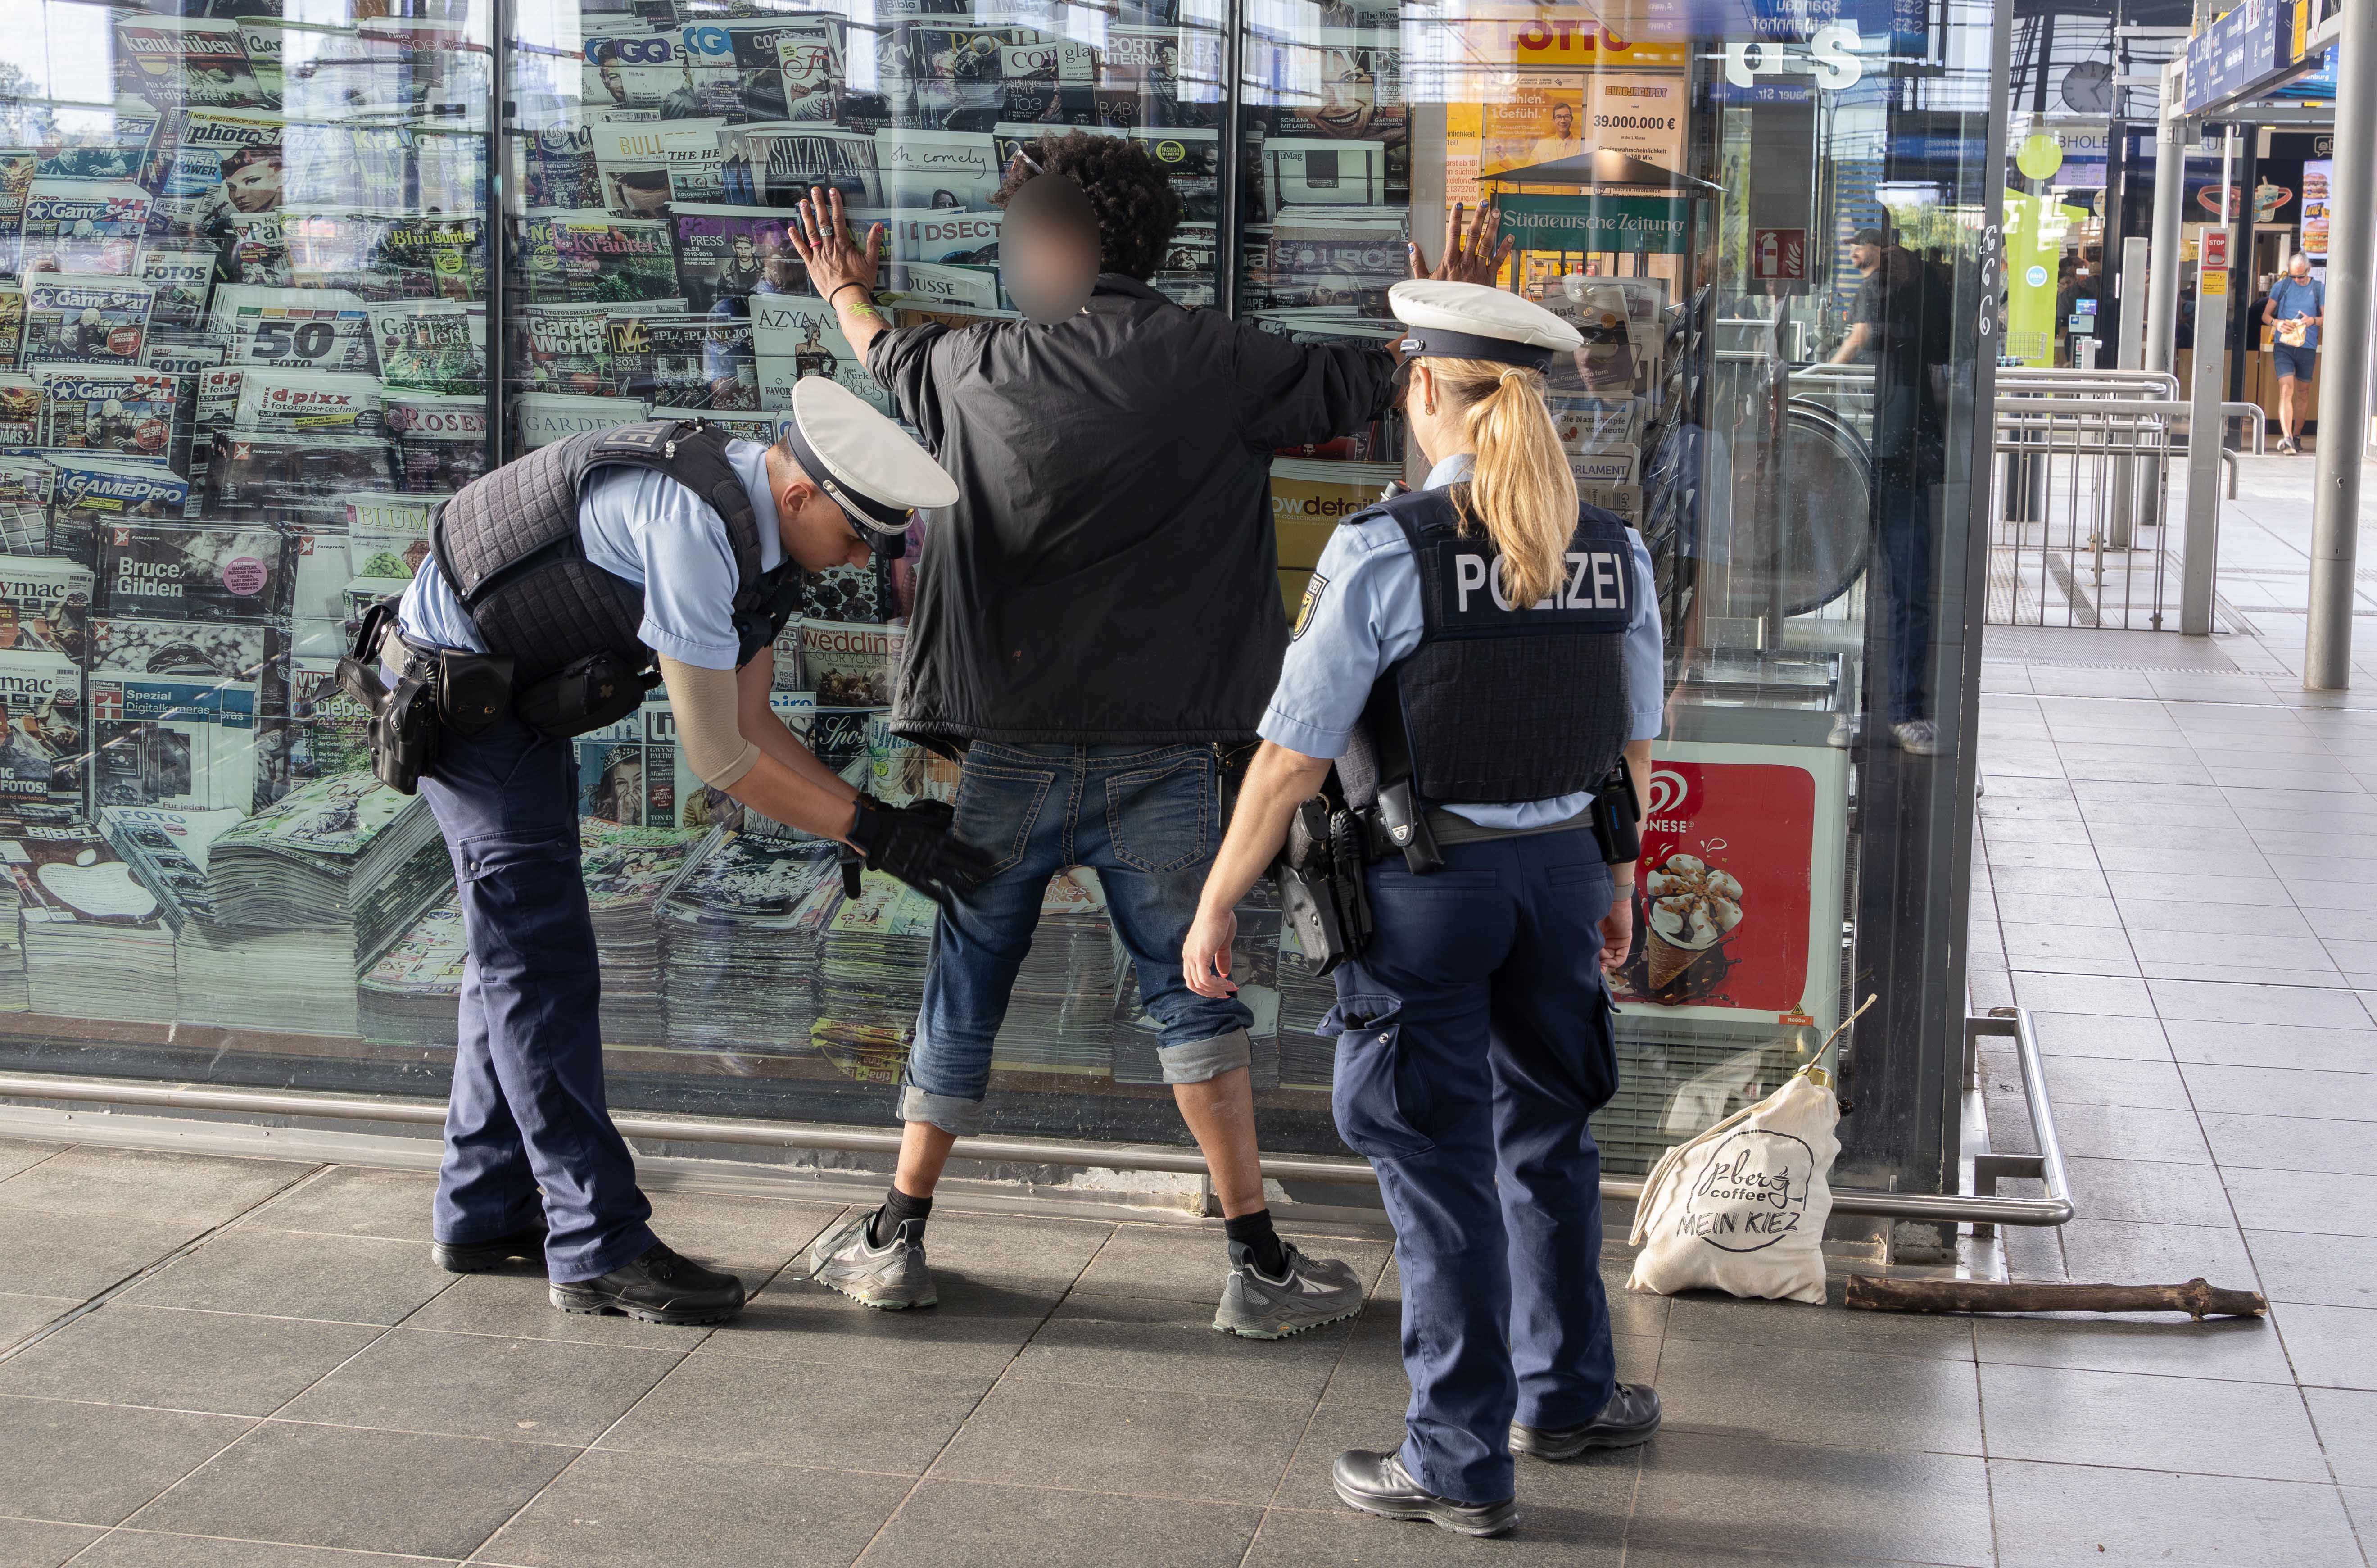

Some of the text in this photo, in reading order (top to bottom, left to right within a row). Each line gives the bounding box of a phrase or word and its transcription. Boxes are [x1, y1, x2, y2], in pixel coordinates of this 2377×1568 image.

[1359, 11, 1399, 19] The Row
[399, 38, 468, 53] special
[614, 38, 673, 63] GQ
[1605, 86, 1667, 98] EUROJACKPOT
[1012, 98, 1042, 111] 103
[1099, 101, 1142, 115] BABY
[209, 115, 248, 124] PHOTOSHOP
[1594, 115, 1675, 130] 39.000.000 €
[668, 151, 697, 160] THE
[1279, 150, 1303, 163] uMag
[923, 148, 986, 179] comely
[1455, 168, 1477, 177] süchtig
[1503, 210, 1684, 237] Süddeutsche Zeitung
[570, 234, 659, 253] Kräuter
[690, 235, 724, 247] PRESS
[1290, 242, 1313, 251] style
[142, 266, 207, 280] FOTOS
[252, 322, 335, 359] 50
[688, 329, 730, 340] PLANT
[531, 335, 603, 353] World
[271, 402, 360, 413] fototipps+technik
[118, 557, 180, 578] Bruce
[117, 576, 183, 598] Gilden
[849, 653, 880, 666] YOUR
[126, 689, 172, 701] Spezial
[126, 702, 210, 715] Digitalkameras
[0, 781, 47, 794] FOTOS!
[163, 801, 178, 809] Für
[120, 811, 186, 824] FOTO
[25, 825, 102, 840] BIBEL
[1711, 1188, 1766, 1202] coffee
[1677, 1211, 1800, 1238] MEIN KIEZ
